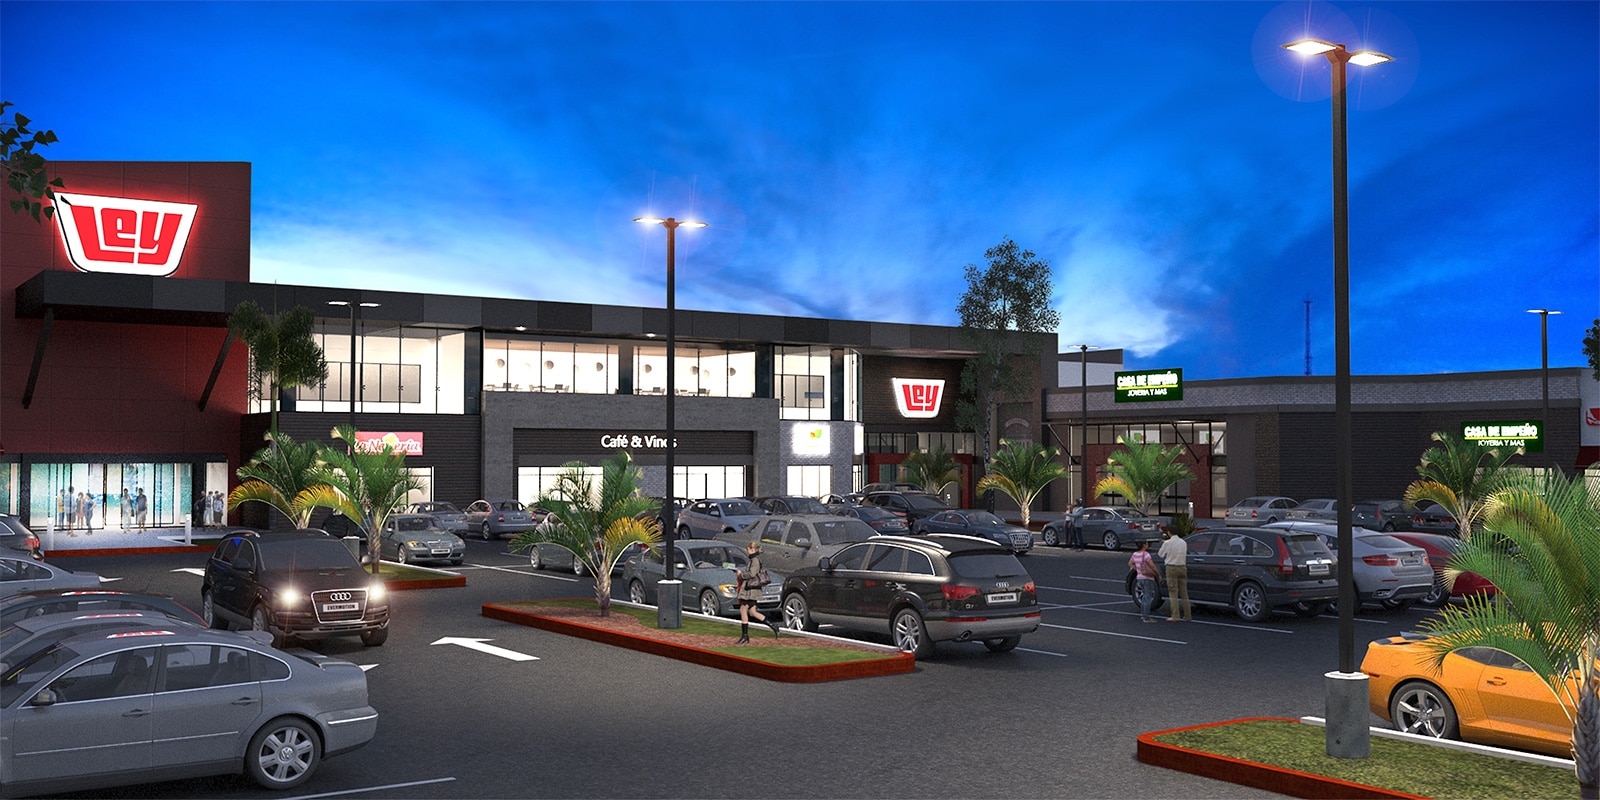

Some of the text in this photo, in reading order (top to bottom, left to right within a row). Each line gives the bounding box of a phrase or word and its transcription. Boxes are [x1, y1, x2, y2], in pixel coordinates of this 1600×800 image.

[70, 204, 183, 265] Ley
[1117, 375, 1136, 387] CASA
[1136, 375, 1147, 386] DE
[902, 384, 939, 411] Ley
[1464, 426, 1487, 437] CASA
[1487, 425, 1500, 437] DE
[601, 434, 629, 448] Café
[631, 435, 642, 448] &
